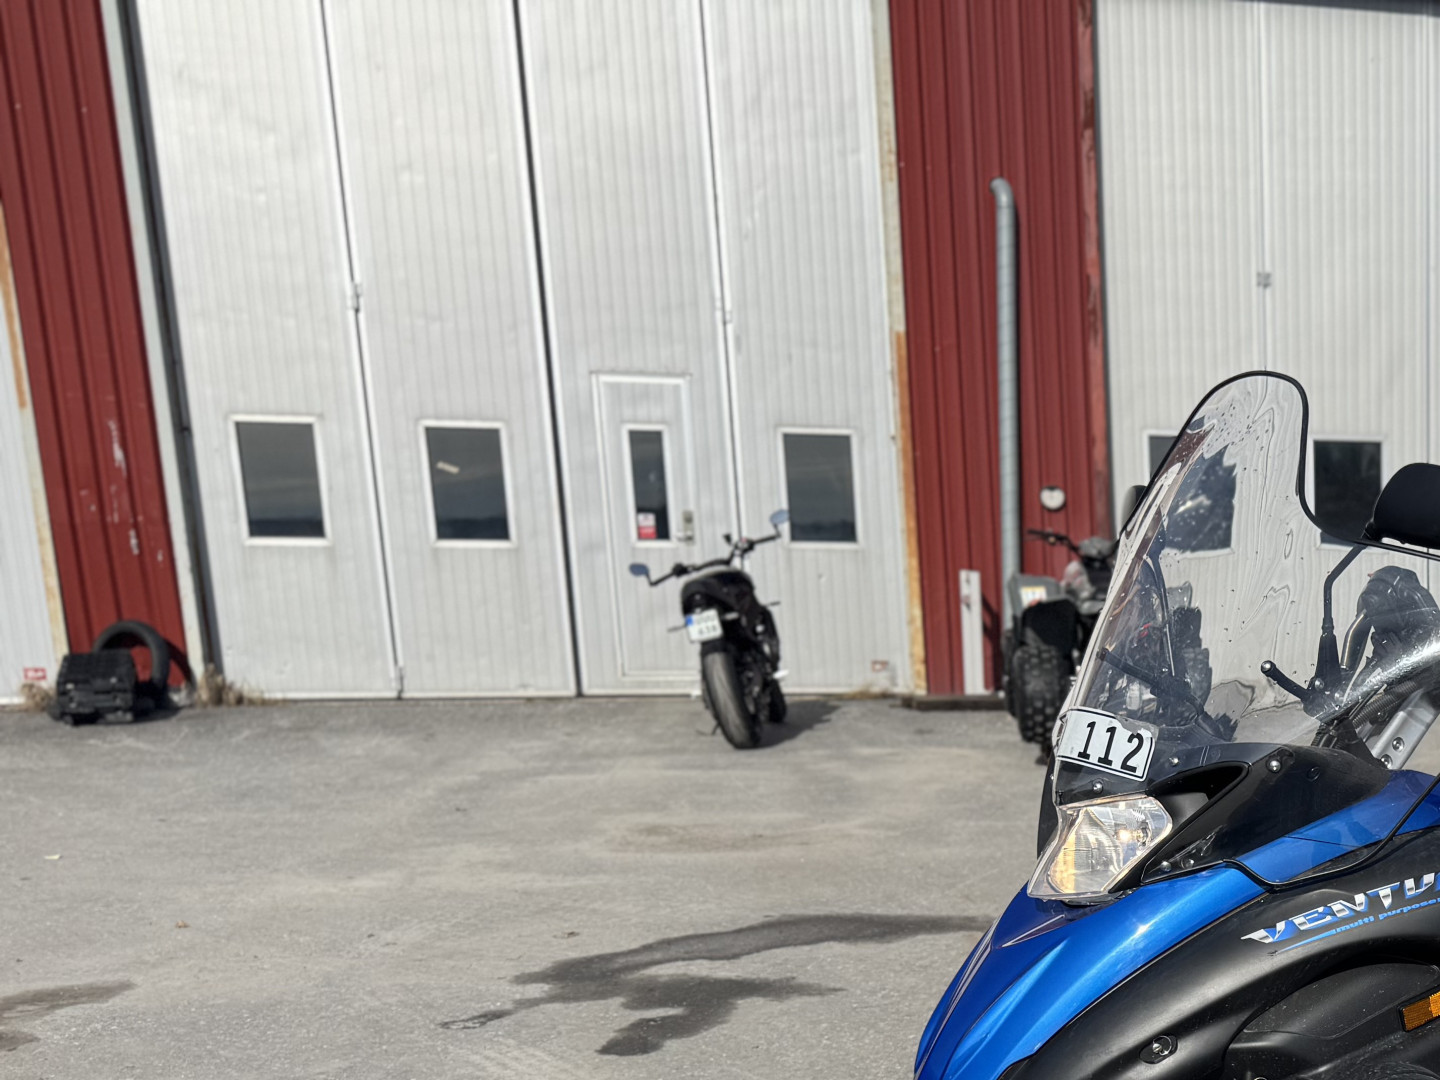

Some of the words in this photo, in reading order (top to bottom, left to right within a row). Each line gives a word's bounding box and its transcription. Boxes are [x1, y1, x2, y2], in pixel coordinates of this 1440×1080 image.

[1077, 721, 1144, 773] 112
[1336, 915, 1375, 934] multi
[1378, 898, 1437, 921] purpose
